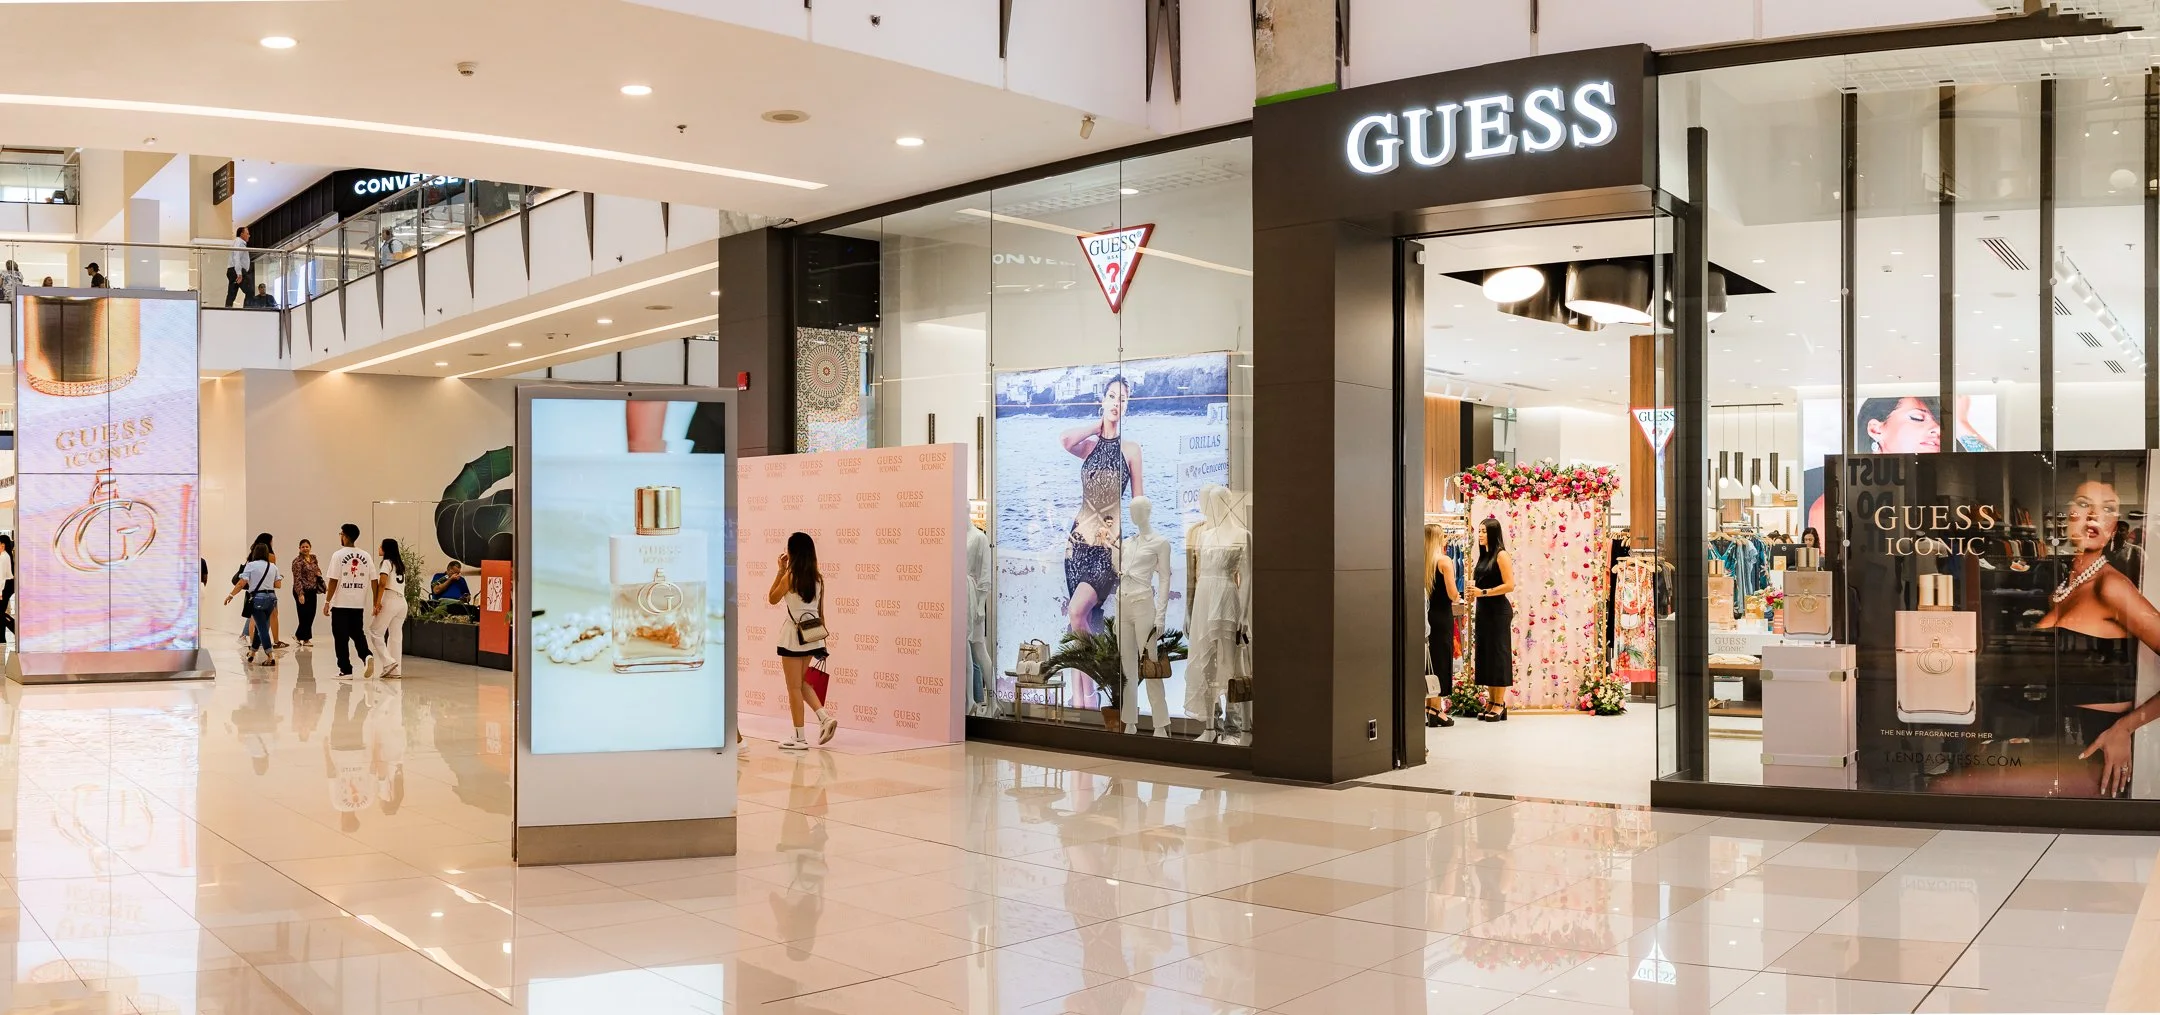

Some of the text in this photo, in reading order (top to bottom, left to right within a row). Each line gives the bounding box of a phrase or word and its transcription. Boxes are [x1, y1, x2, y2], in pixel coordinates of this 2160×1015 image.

[1346, 80, 1617, 175] GUESS
[1639, 410, 1674, 422] GUESS
[56, 415, 154, 450] GUESS
[1190, 434, 1220, 450] ORILLAS
[64, 441, 148, 469] ICONIC
[919, 453, 946, 462] GUESS
[800, 460, 823, 469] GUESS
[838, 458, 861, 467] GUESS
[877, 455, 902, 465] GUESS
[764, 462, 787, 470] GUESS
[782, 495, 804, 503] GUESS
[818, 494, 841, 502] GUESS
[856, 492, 881, 501] GUESS
[896, 491, 924, 500] GUESS
[1874, 504, 1994, 530] GUESS
[764, 528, 785, 537] GUESS
[836, 528, 860, 536] GUESS
[876, 528, 901, 536] GUESS
[918, 528, 946, 536] GUESS
[1885, 537, 1986, 556] ICONIC
[856, 564, 880, 572] GUESS
[896, 565, 923, 573] GUESS
[836, 598, 859, 607] GUESS
[875, 600, 900, 609] GUESS
[918, 602, 944, 611] GUESS
[746, 626, 766, 634] GUESS
[854, 634, 879, 644] GUESS
[895, 637, 922, 647] GUESS
[1714, 637, 1747, 645] GUESS
[834, 667, 858, 678] GUESS
[874, 672, 899, 681] GUESS
[916, 676, 944, 686] GUESS
[876, 682, 897, 690] ICONIC
[919, 686, 942, 695] ICONIC
[745, 690, 765, 700] GUESS
[853, 705, 878, 715] GUESS
[894, 710, 920, 721] GUESS
[896, 720, 918, 729] ICONIC
